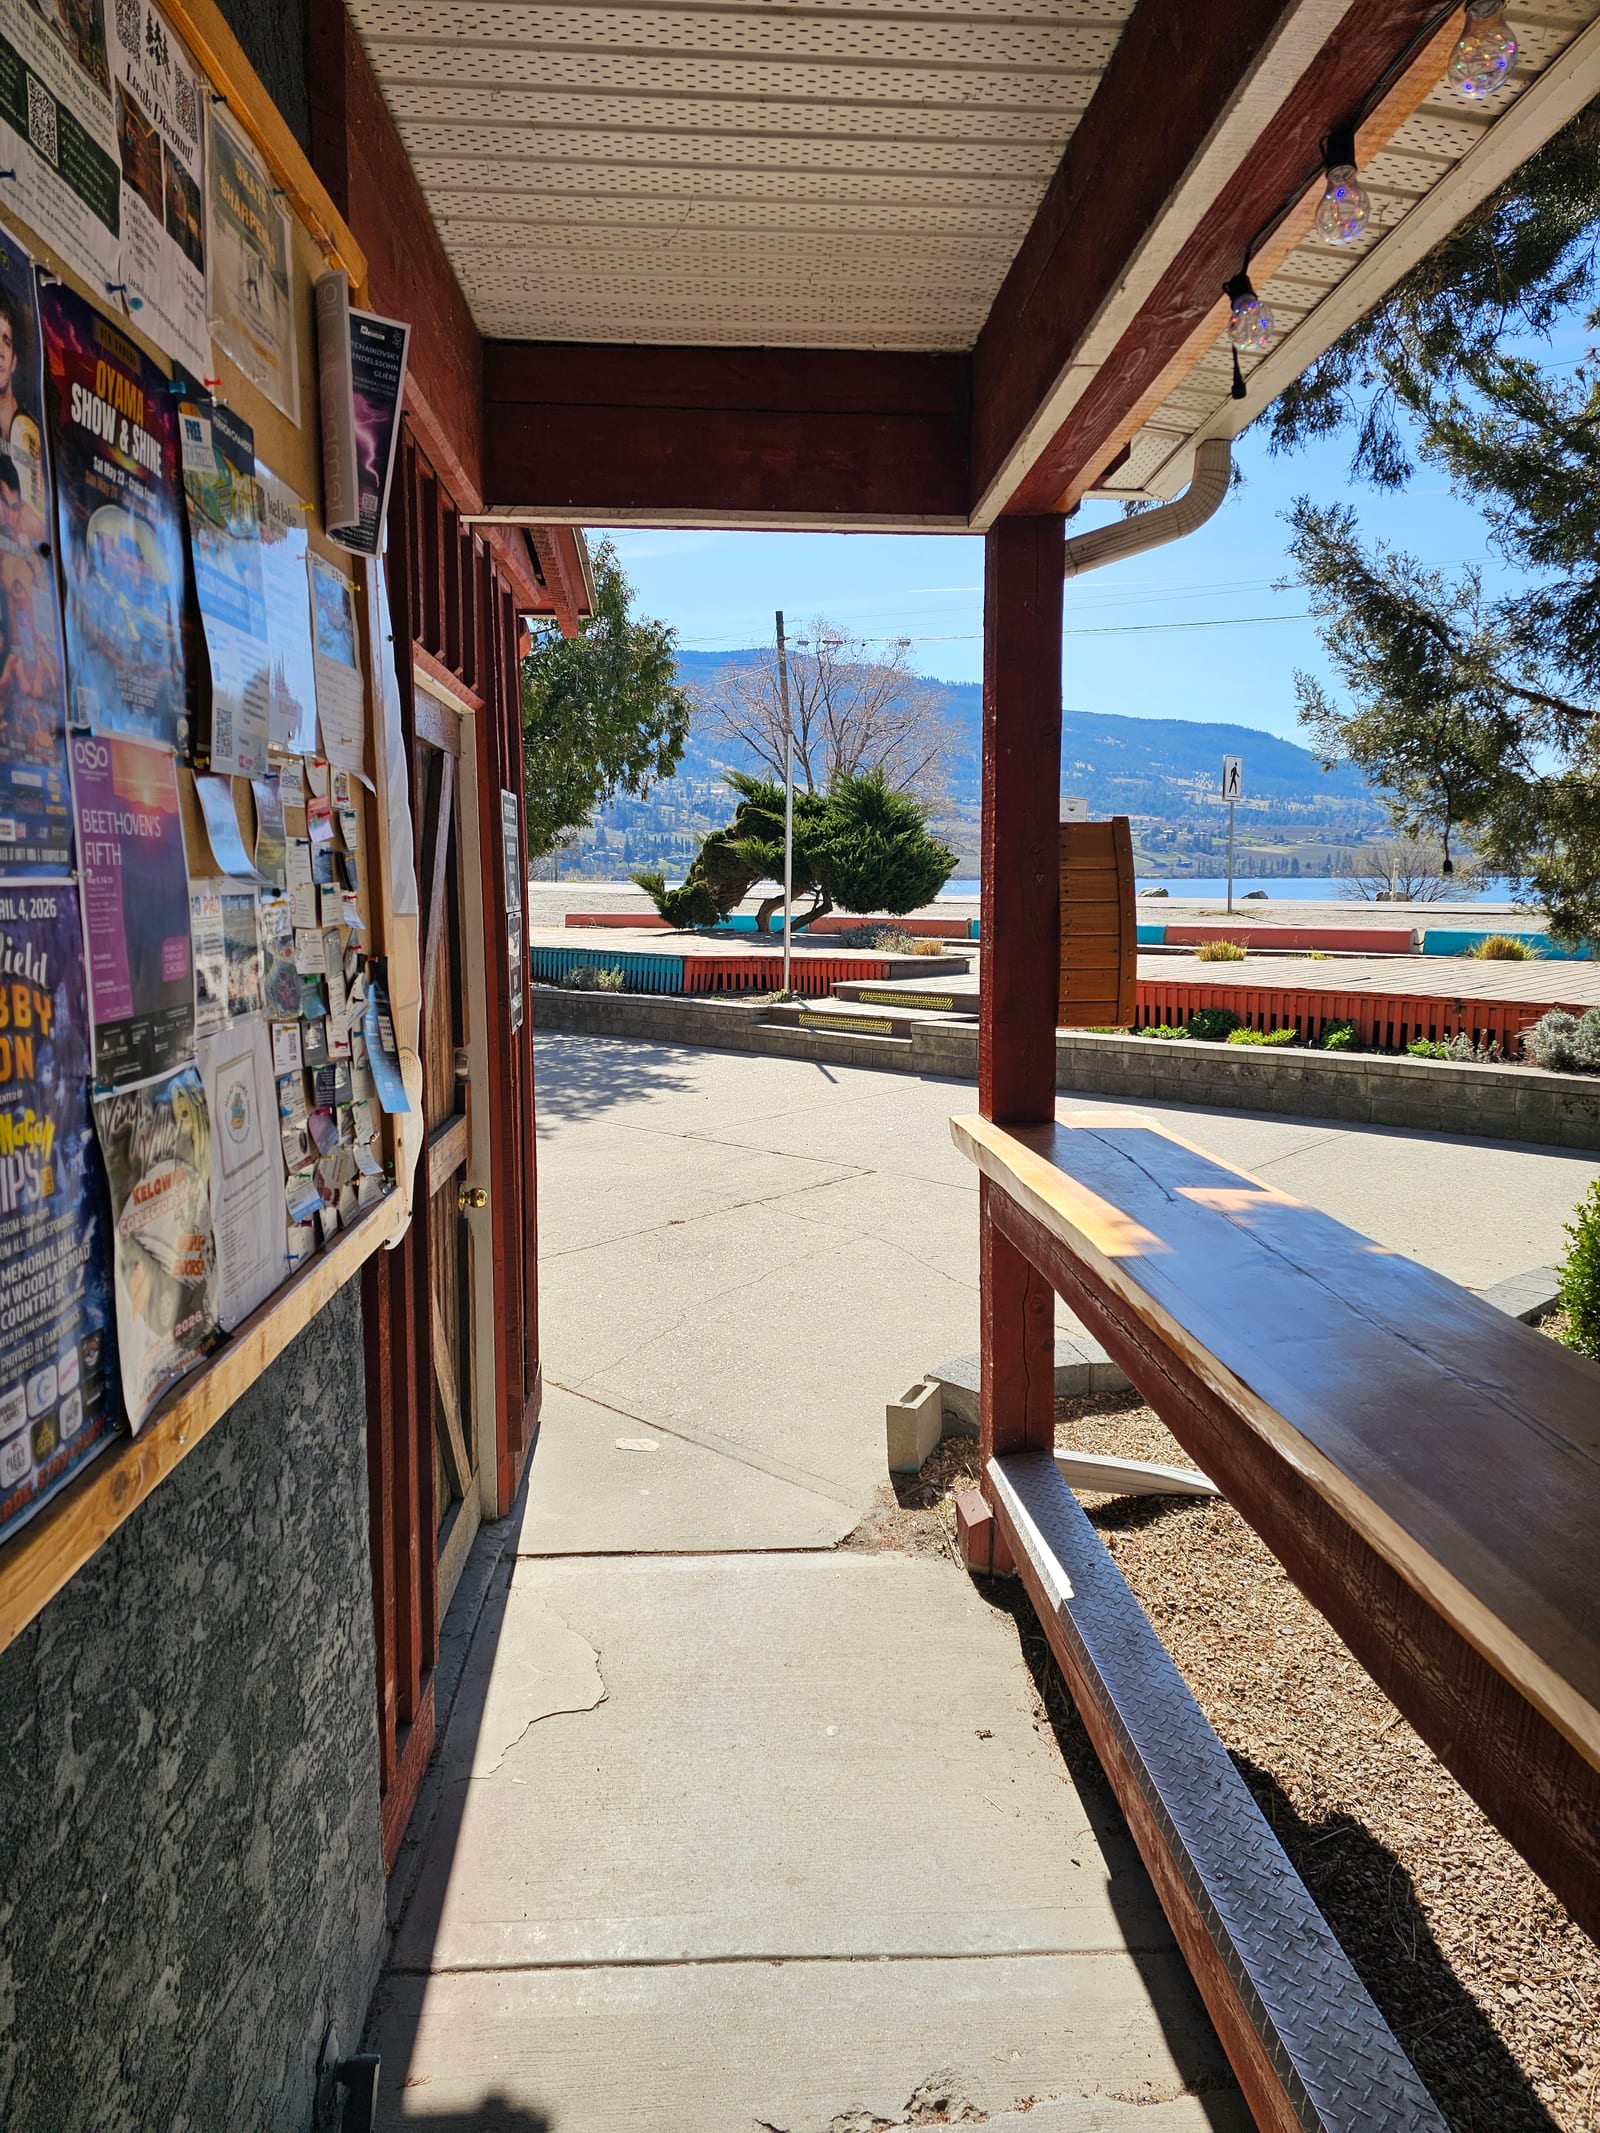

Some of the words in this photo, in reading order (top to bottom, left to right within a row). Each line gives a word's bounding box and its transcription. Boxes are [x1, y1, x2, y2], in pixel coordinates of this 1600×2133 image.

[352, 352, 399, 372] ENDELSSOHN
[95, 359, 144, 426] OYAMA
[71, 382, 116, 445] SHOW
[119, 419, 129, 454] &
[132, 424, 163, 479] SHINE
[93, 455, 104, 476] Sat
[104, 461, 116, 484] May
[82, 809, 161, 838] BEETHOVEN'S
[85, 841, 121, 865] FIFTH
[18, 899, 29, 921] 4,
[30, 897, 57, 919] 2026
[0, 1216, 20, 1239] FROM
[1, 1247, 57, 1288] MEMORIAL
[57, 1232, 78, 1258] HALL
[12, 1273, 46, 1302] WOOD
[69, 1244, 90, 1273] ROAD
[1, 1288, 55, 1331] COUNTRY,
[55, 1281, 66, 1300] BC
[174, 1310, 204, 1337] 2026
